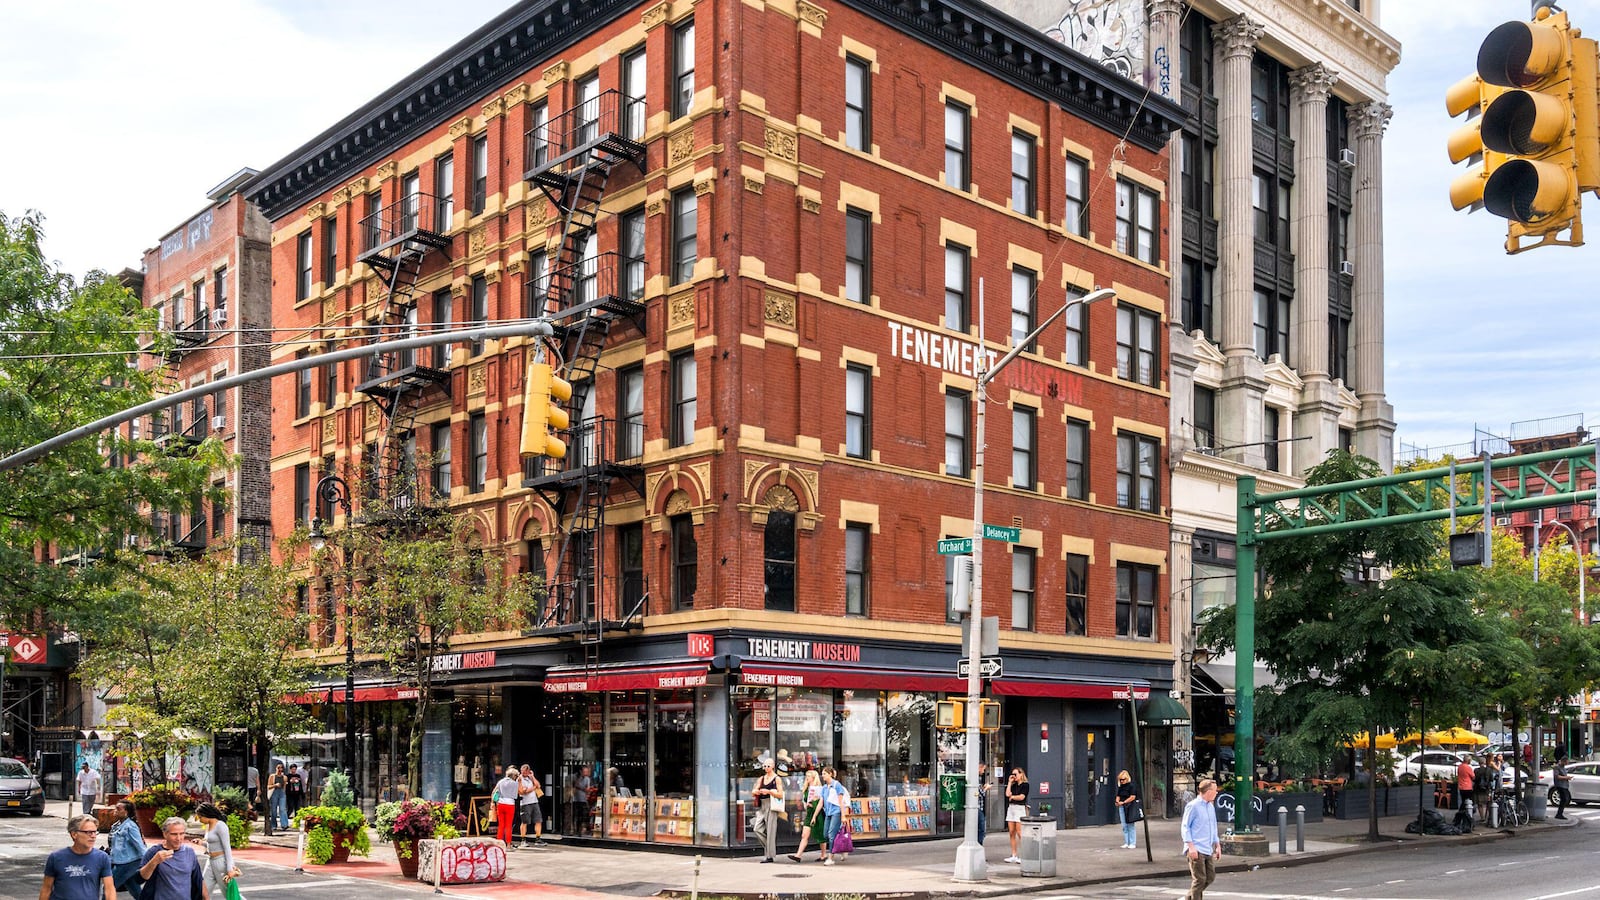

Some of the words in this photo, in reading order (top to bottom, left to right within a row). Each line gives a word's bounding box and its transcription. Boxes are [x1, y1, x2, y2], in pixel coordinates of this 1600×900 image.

[1004, 357, 1083, 405] MUSEUM
[986, 526, 1010, 541] Delancey
[940, 541, 964, 553] Orchard
[748, 638, 809, 659] TENEMENT
[812, 642, 860, 661] MUSEUM
[426, 654, 462, 672] TNEMENT
[463, 651, 496, 669] MUSEUM
[658, 676, 684, 688] TENEMENT
[743, 673, 776, 685] TENEMENT
[777, 674, 804, 686] MUSEUM
